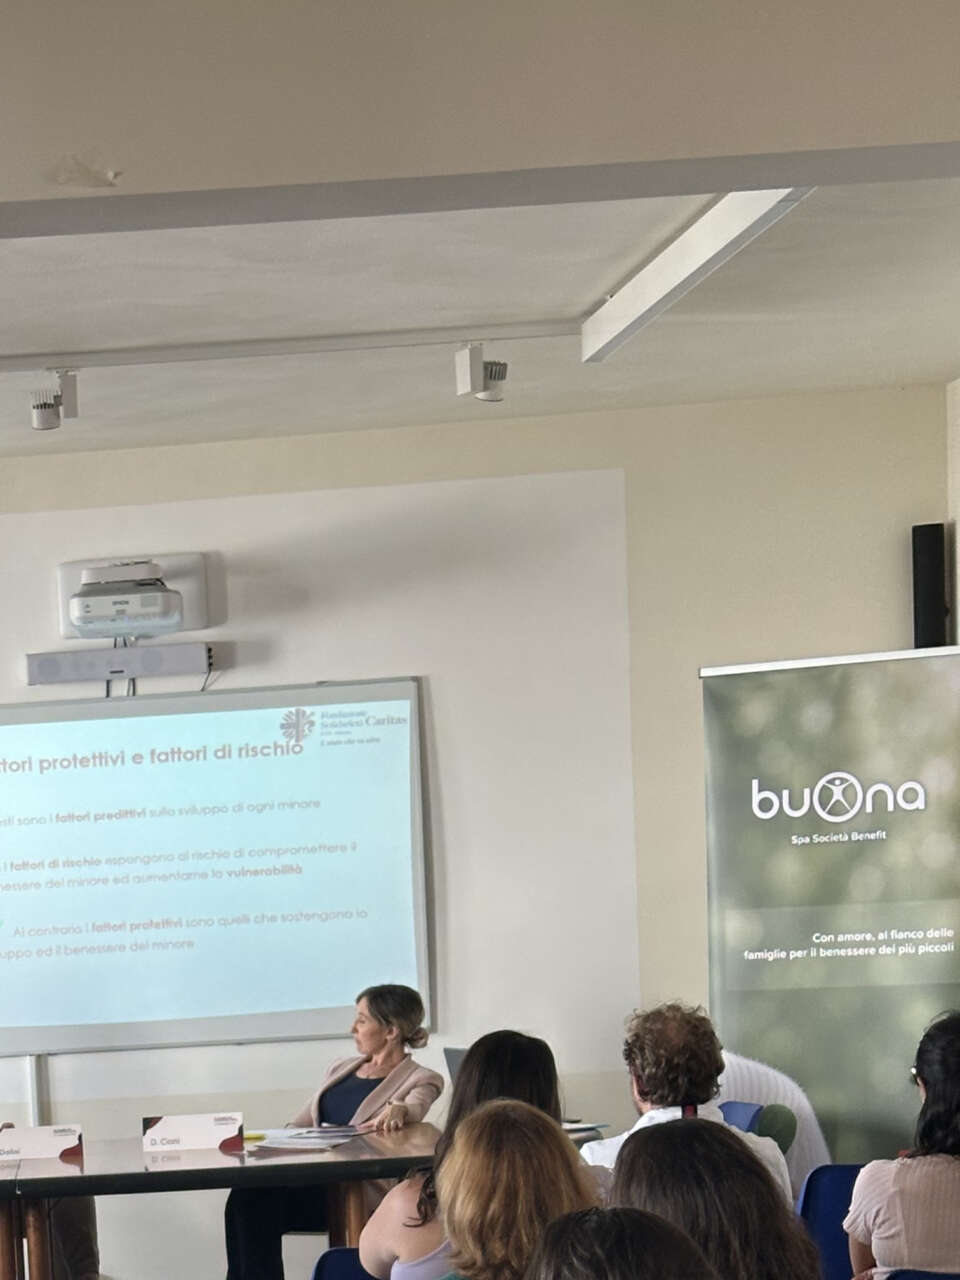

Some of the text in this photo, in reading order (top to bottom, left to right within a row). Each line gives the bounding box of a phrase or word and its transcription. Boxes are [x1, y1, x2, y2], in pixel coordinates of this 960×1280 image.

[39, 751, 125, 775] protettivi
[131, 752, 144, 765] e
[150, 745, 207, 764] fattori
[214, 744, 232, 760] di
[238, 740, 304, 759] rischio
[17, 816, 46, 826] sono
[55, 811, 90, 823] fattori
[178, 804, 228, 817] sviluppo
[232, 802, 243, 812] di
[247, 800, 274, 814] ogni
[277, 799, 320, 809] minore
[791, 829, 887, 846] Spa Società Benefit
[10, 860, 45, 872] fattori
[48, 858, 60, 870] di
[62, 856, 101, 869] rischio
[234, 847, 245, 858] di
[67, 876, 109, 888] minore
[112, 873, 129, 884] ed
[92, 920, 126, 933] fattori
[186, 917, 215, 929] sono
[253, 912, 278, 925] che
[281, 908, 353, 923] sostengono
[812, 932, 834, 944] Con
[877, 929, 888, 940] al
[890, 928, 924, 940] fianco
[926, 927, 954, 938] delle
[36, 944, 53, 957] ed
[64, 941, 126, 956] benessere
[744, 948, 787, 963] famiglie
[789, 949, 807, 960] per
[810, 946, 817, 957] il
[819, 945, 876, 957] benessere
[898, 942, 916, 956] più
[918, 941, 954, 955] piccoli
